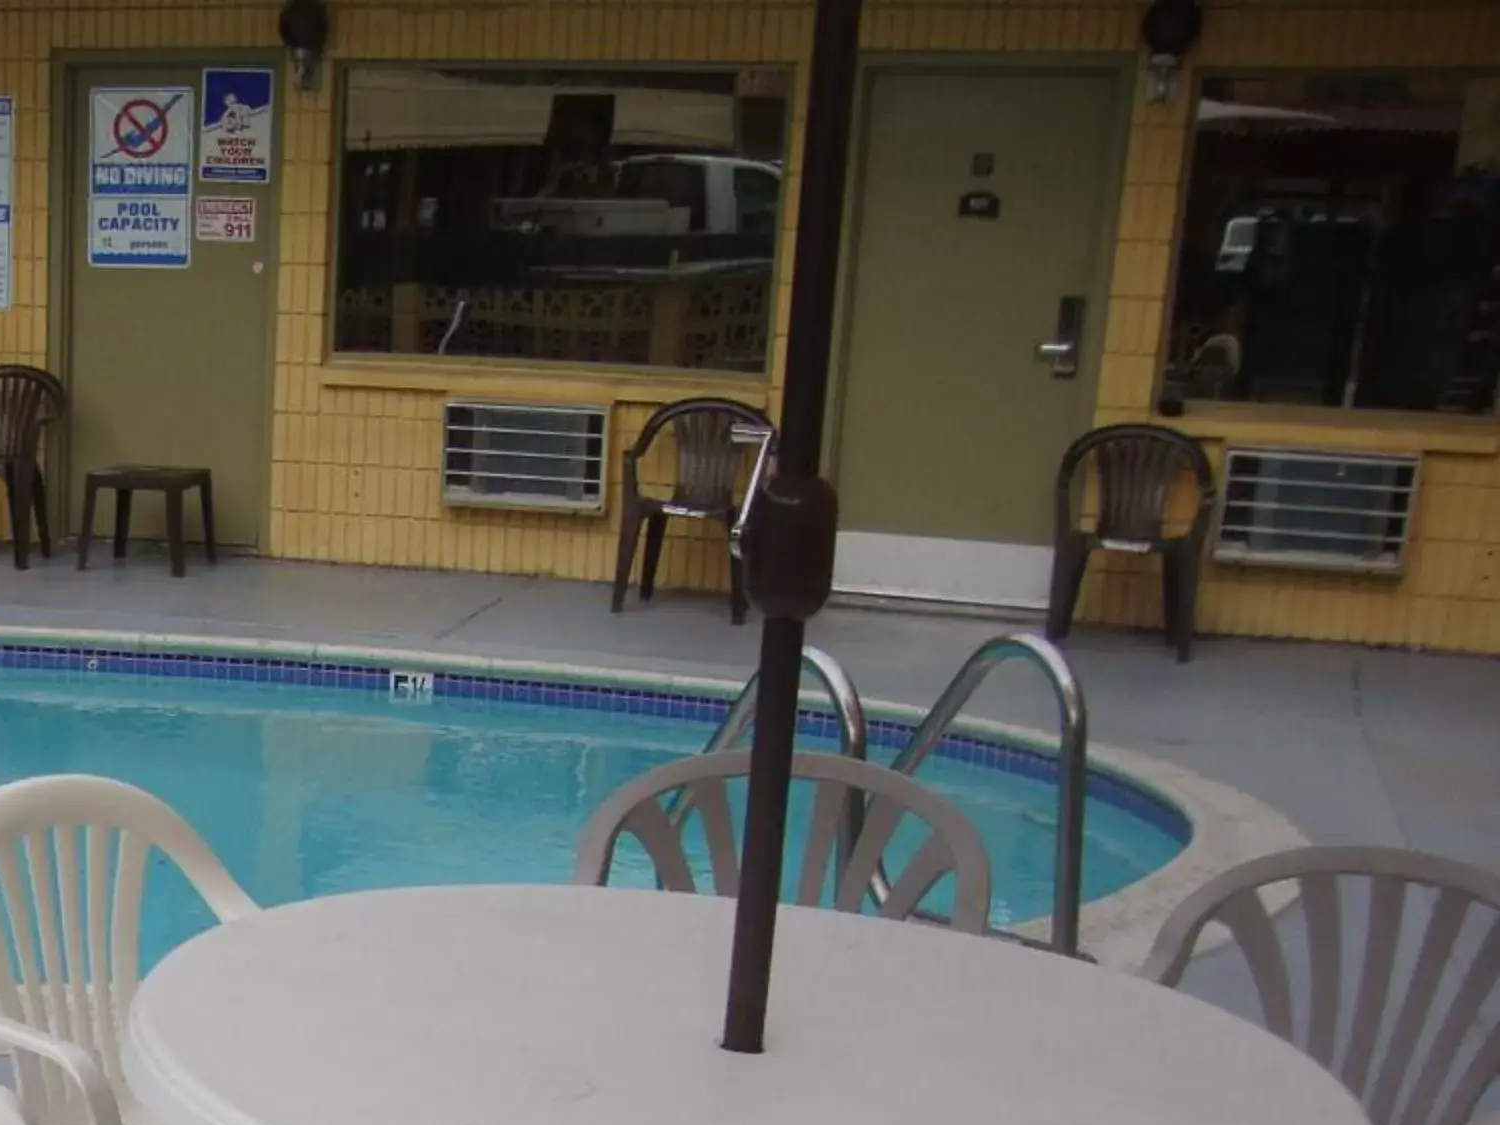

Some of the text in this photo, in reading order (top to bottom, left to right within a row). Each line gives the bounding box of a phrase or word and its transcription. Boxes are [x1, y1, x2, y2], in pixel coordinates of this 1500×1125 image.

[217, 137, 256, 147] WATCH
[206, 156, 266, 166] CHILDREN
[95, 166, 121, 185] NO
[123, 166, 186, 186] DIVING
[117, 202, 161, 216] POOL
[98, 217, 180, 231] CAPACITY
[224, 223, 252, 237] 911
